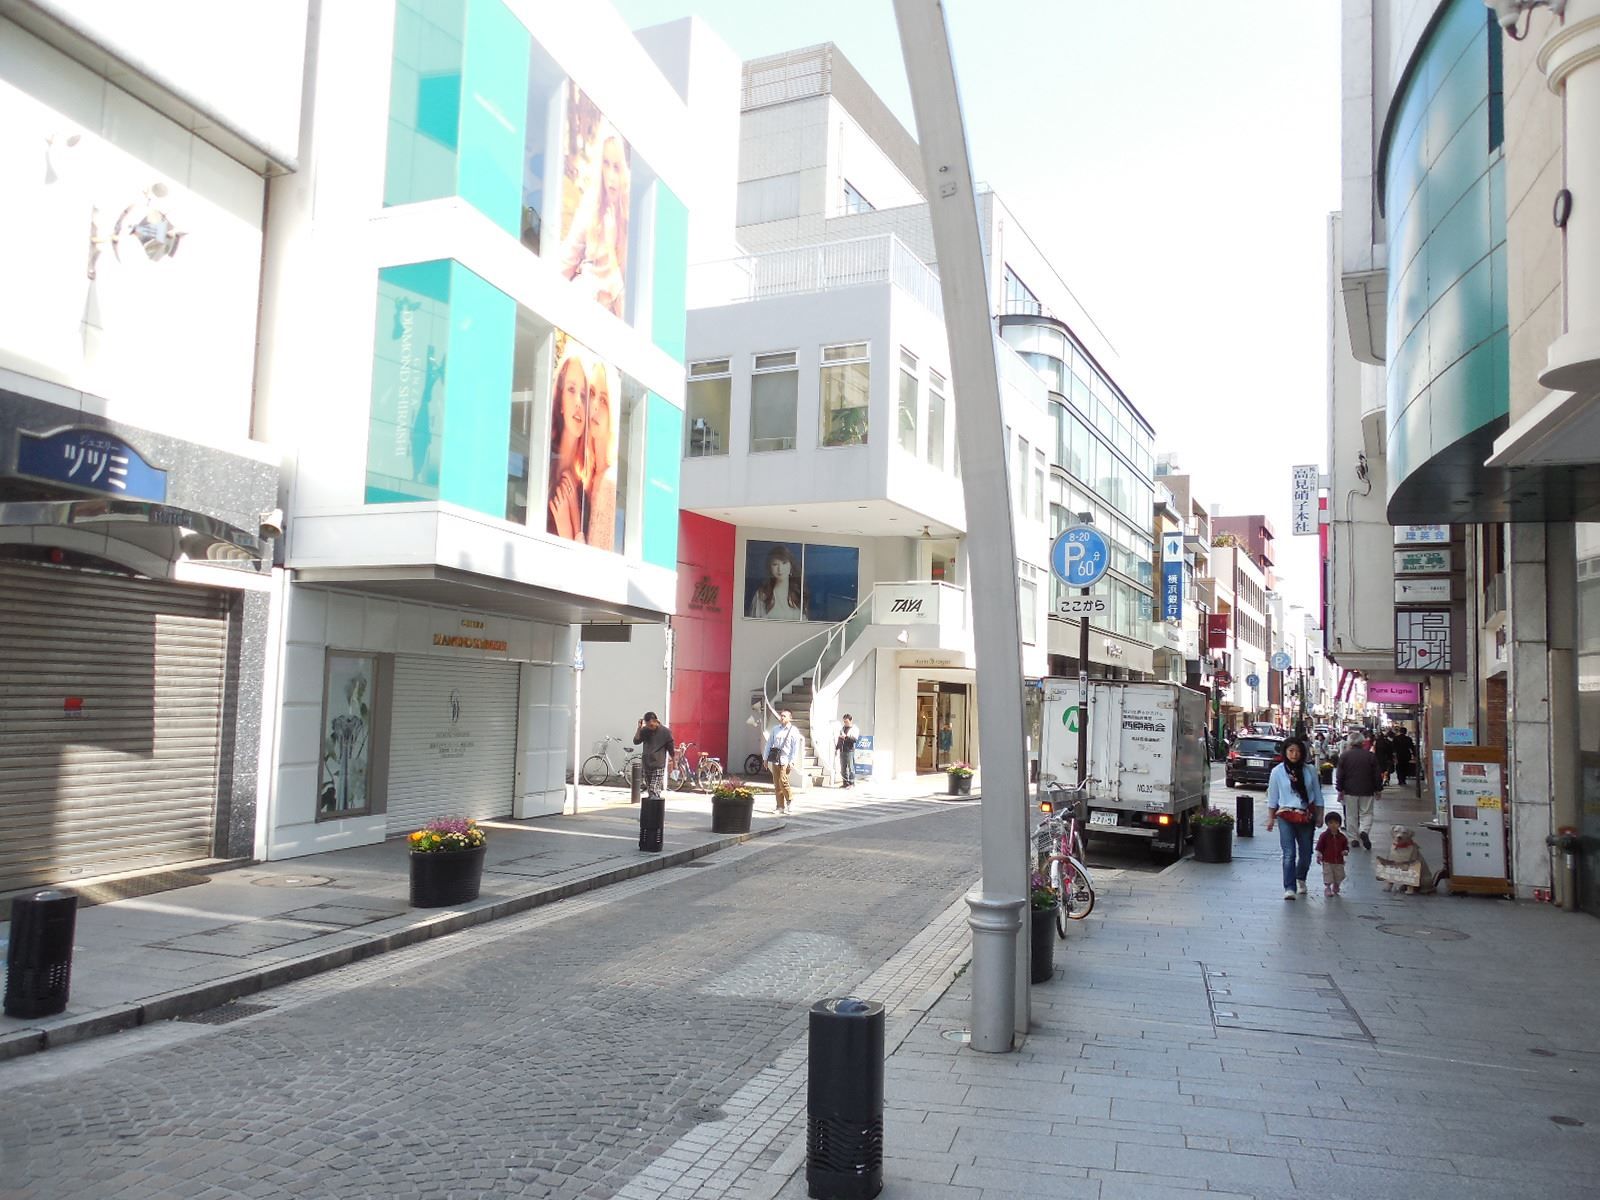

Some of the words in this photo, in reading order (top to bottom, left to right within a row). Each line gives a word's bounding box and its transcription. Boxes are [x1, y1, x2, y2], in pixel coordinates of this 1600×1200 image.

[64, 444, 129, 490] ツツミ
[1294, 468, 1310, 533] 高見硝子本社
[1069, 532, 1090, 542] 8-20
[1064, 541, 1086, 577] P
[1092, 551, 1100, 562] 分
[1077, 560, 1094, 576] 60
[1167, 574, 1179, 615] 横浜銀行
[891, 599, 923, 613] TAYA
[1061, 599, 1106, 612] ここから
[1122, 721, 1166, 732] 西原商会
